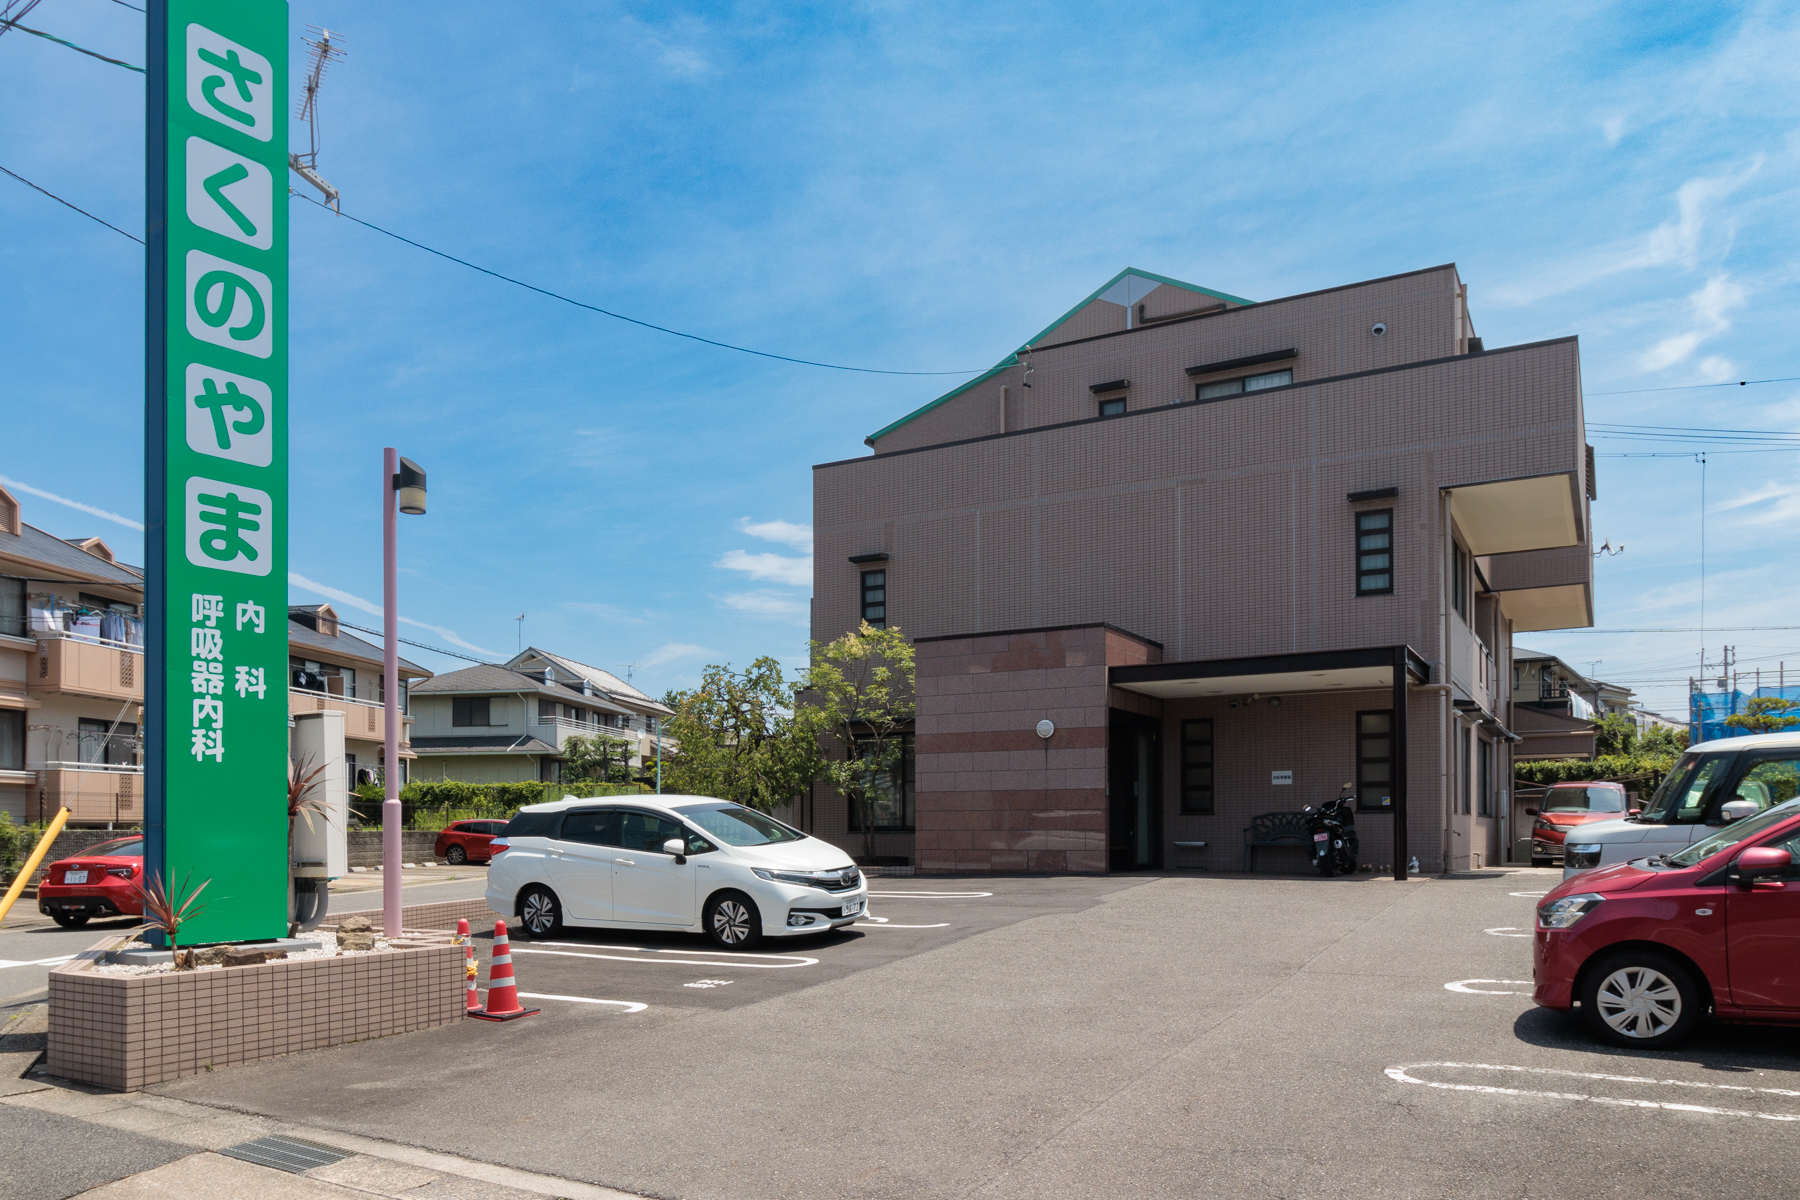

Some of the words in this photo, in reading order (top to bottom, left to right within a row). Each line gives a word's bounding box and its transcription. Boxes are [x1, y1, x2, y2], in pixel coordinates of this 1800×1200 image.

[194, 48, 266, 562] さくのやま
[191, 593, 224, 763] 呼吸器内科
[235, 600, 267, 699] 内科
